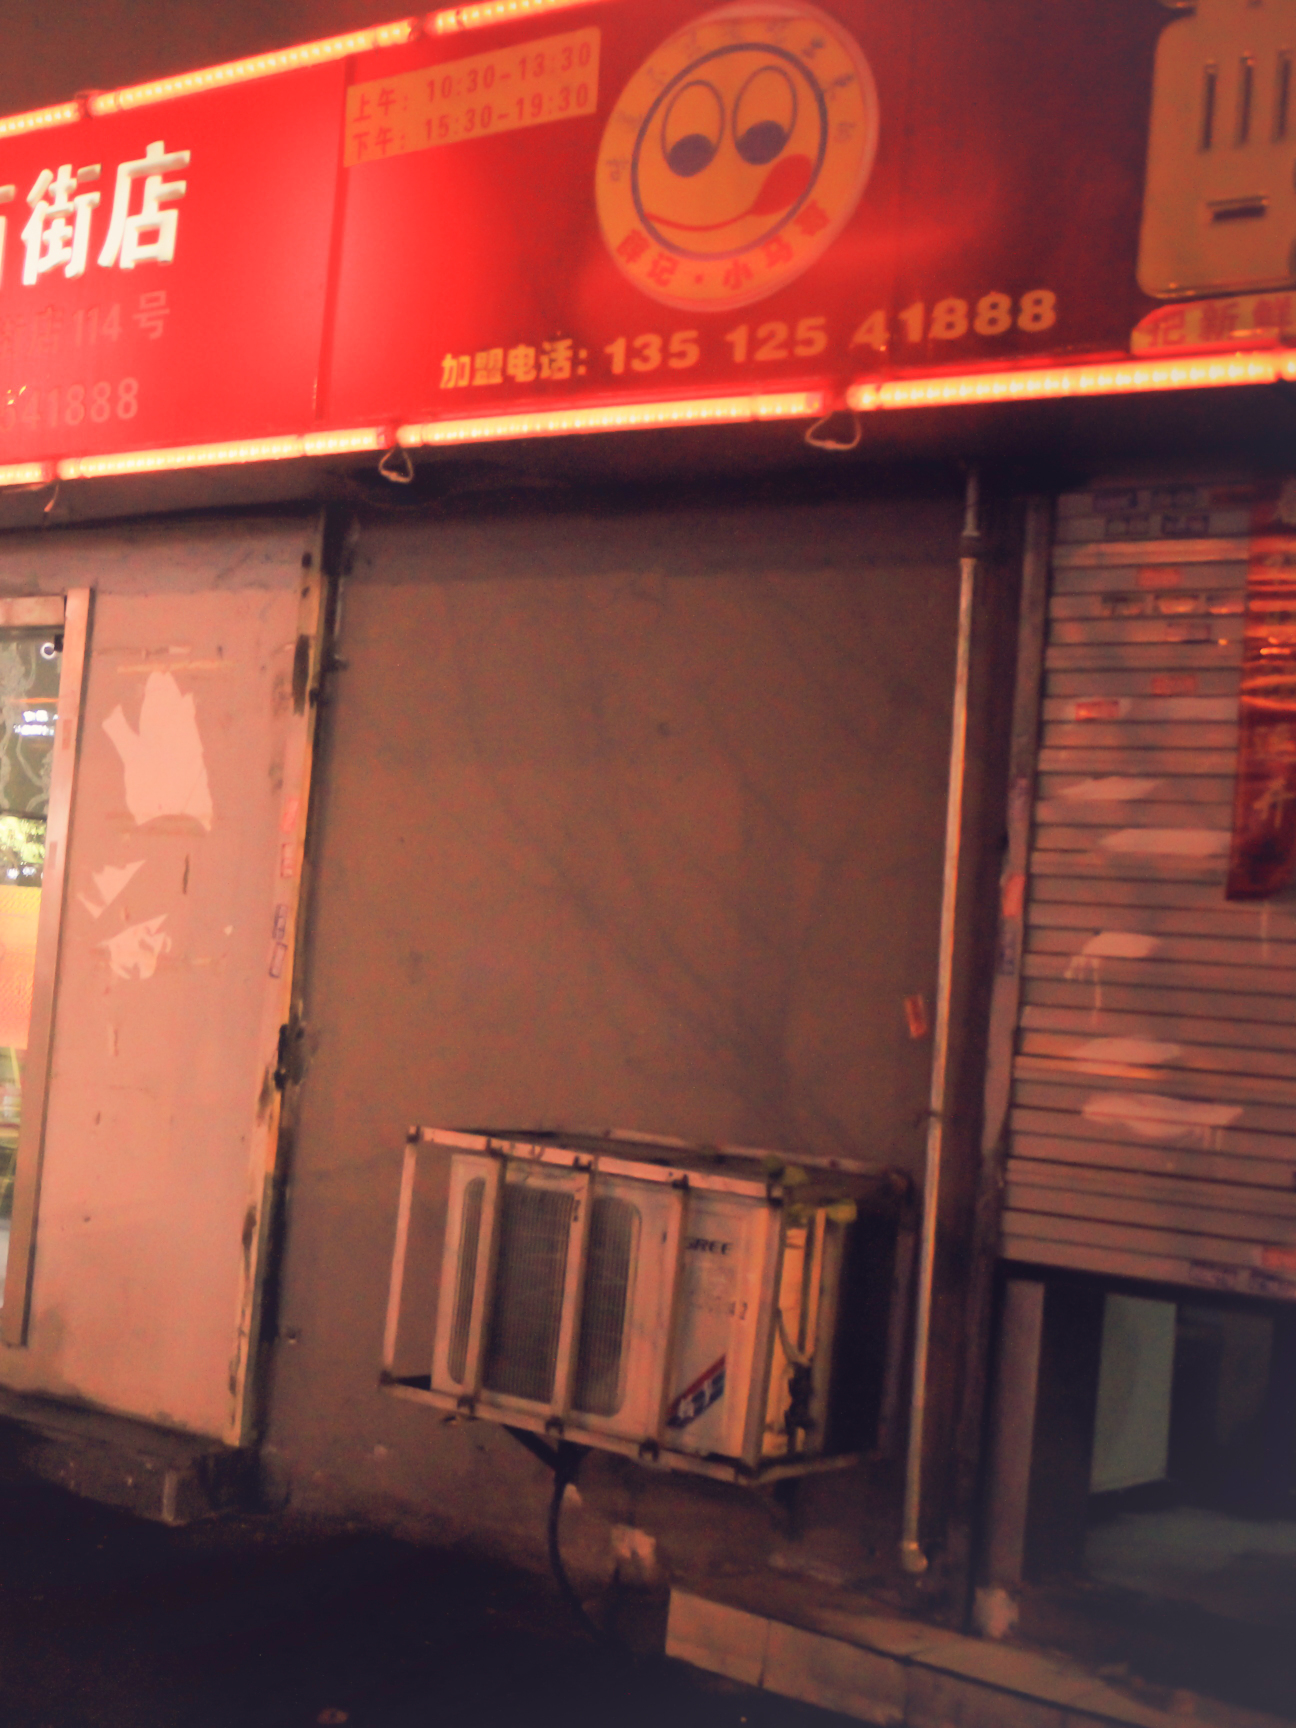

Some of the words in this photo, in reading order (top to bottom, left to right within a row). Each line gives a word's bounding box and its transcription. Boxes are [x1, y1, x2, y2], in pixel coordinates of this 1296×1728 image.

[604, 328, 702, 375] 135
[723, 316, 828, 364] 125
[849, 288, 1057, 352] 41888
